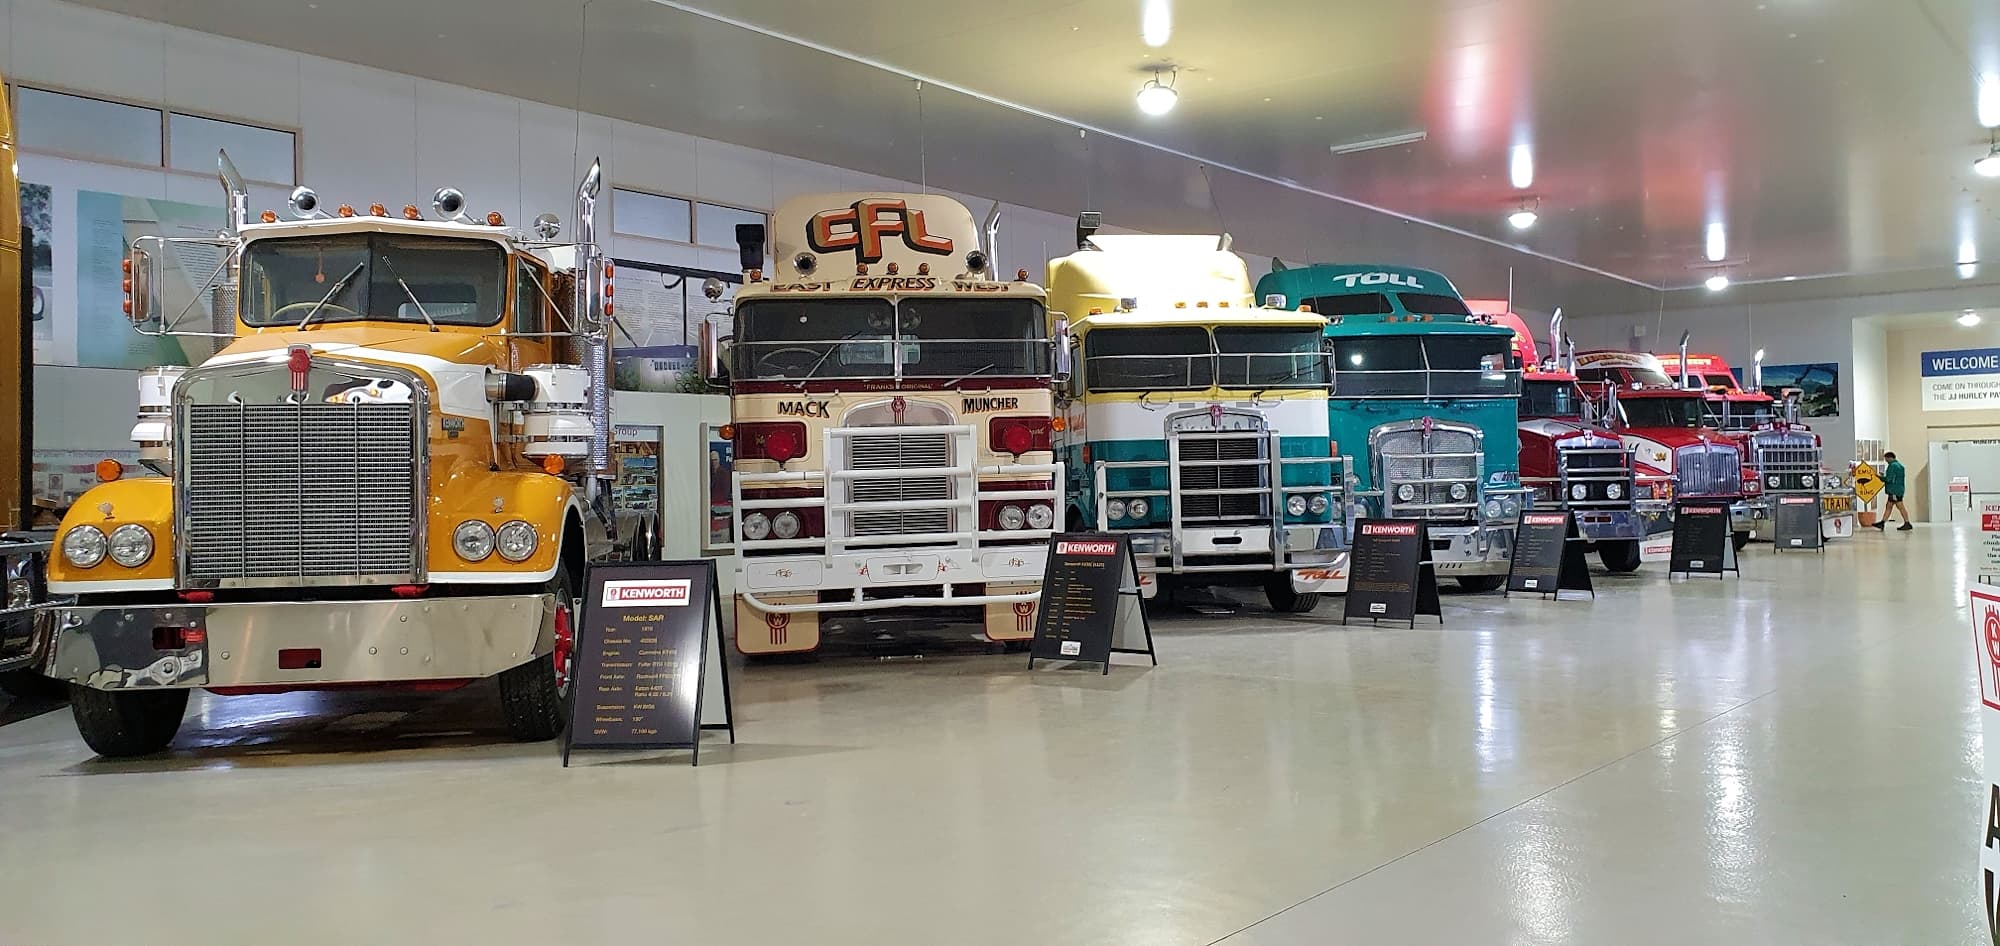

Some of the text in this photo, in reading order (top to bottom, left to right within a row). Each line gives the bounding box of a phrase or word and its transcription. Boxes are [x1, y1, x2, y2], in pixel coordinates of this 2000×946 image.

[849, 277, 936, 292] EXPRESS
[1332, 272, 1425, 289] TOLL
[1932, 355, 1999, 370] WELCOME
[1932, 383, 1952, 391] COME
[1958, 391, 1988, 400] HURLEY
[777, 401, 830, 419] MACK
[961, 397, 1019, 414] MUNCHER
[1824, 497, 1850, 510] TRAIN
[1372, 526, 1415, 534] KENWORTH
[1067, 543, 1115, 553] KENWORTH
[621, 587, 685, 599] KENWORTH
[623, 614, 665, 622] Model: SAR
